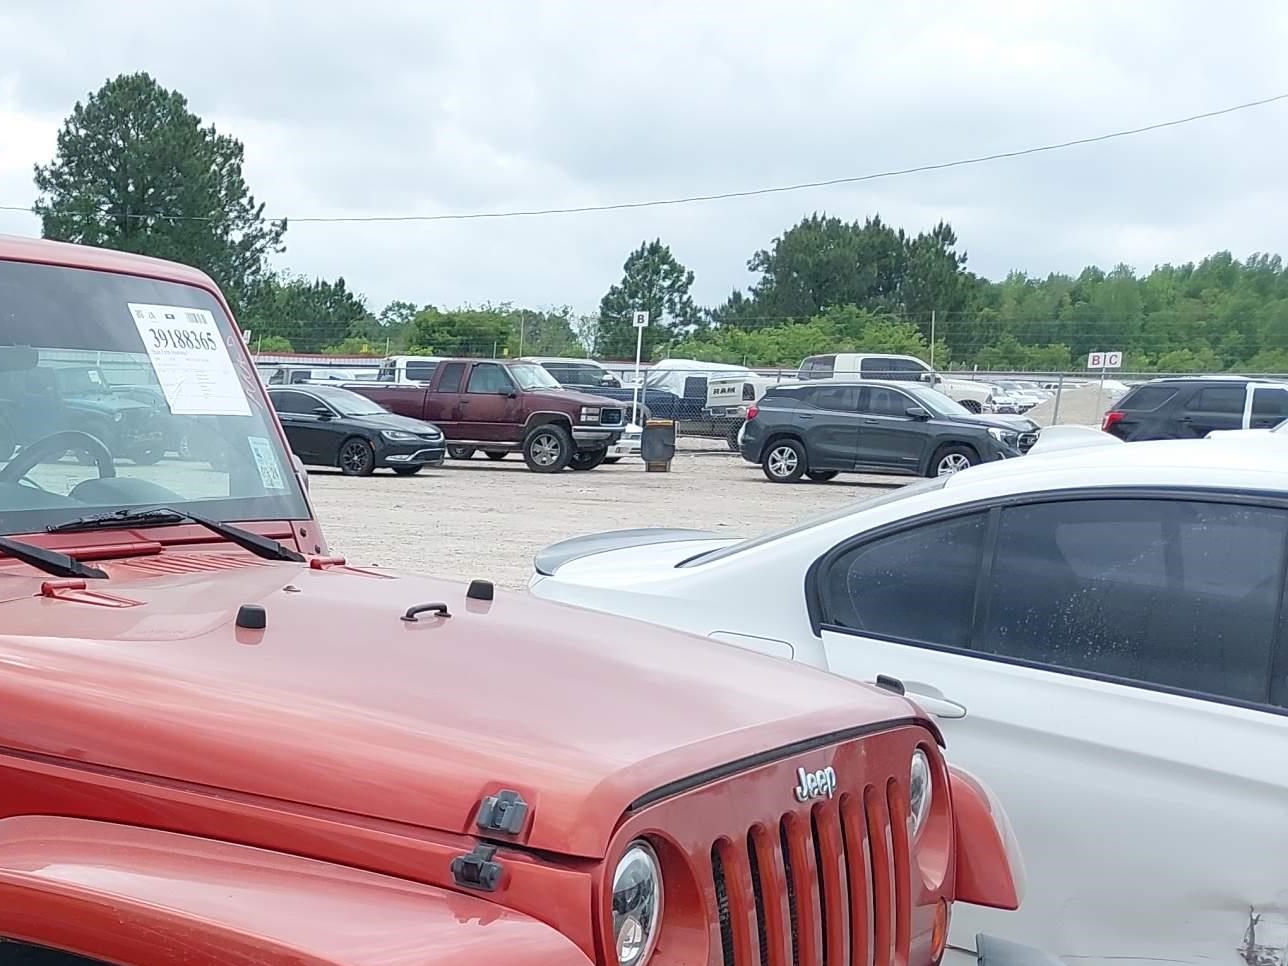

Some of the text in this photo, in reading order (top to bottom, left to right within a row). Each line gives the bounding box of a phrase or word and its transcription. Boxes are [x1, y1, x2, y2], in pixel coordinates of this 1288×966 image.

[637, 315, 645, 324] B
[149, 328, 217, 351] 39188365
[1092, 354, 1118, 365] B C
[713, 387, 736, 395] RAM
[794, 766, 837, 803] Jeep
